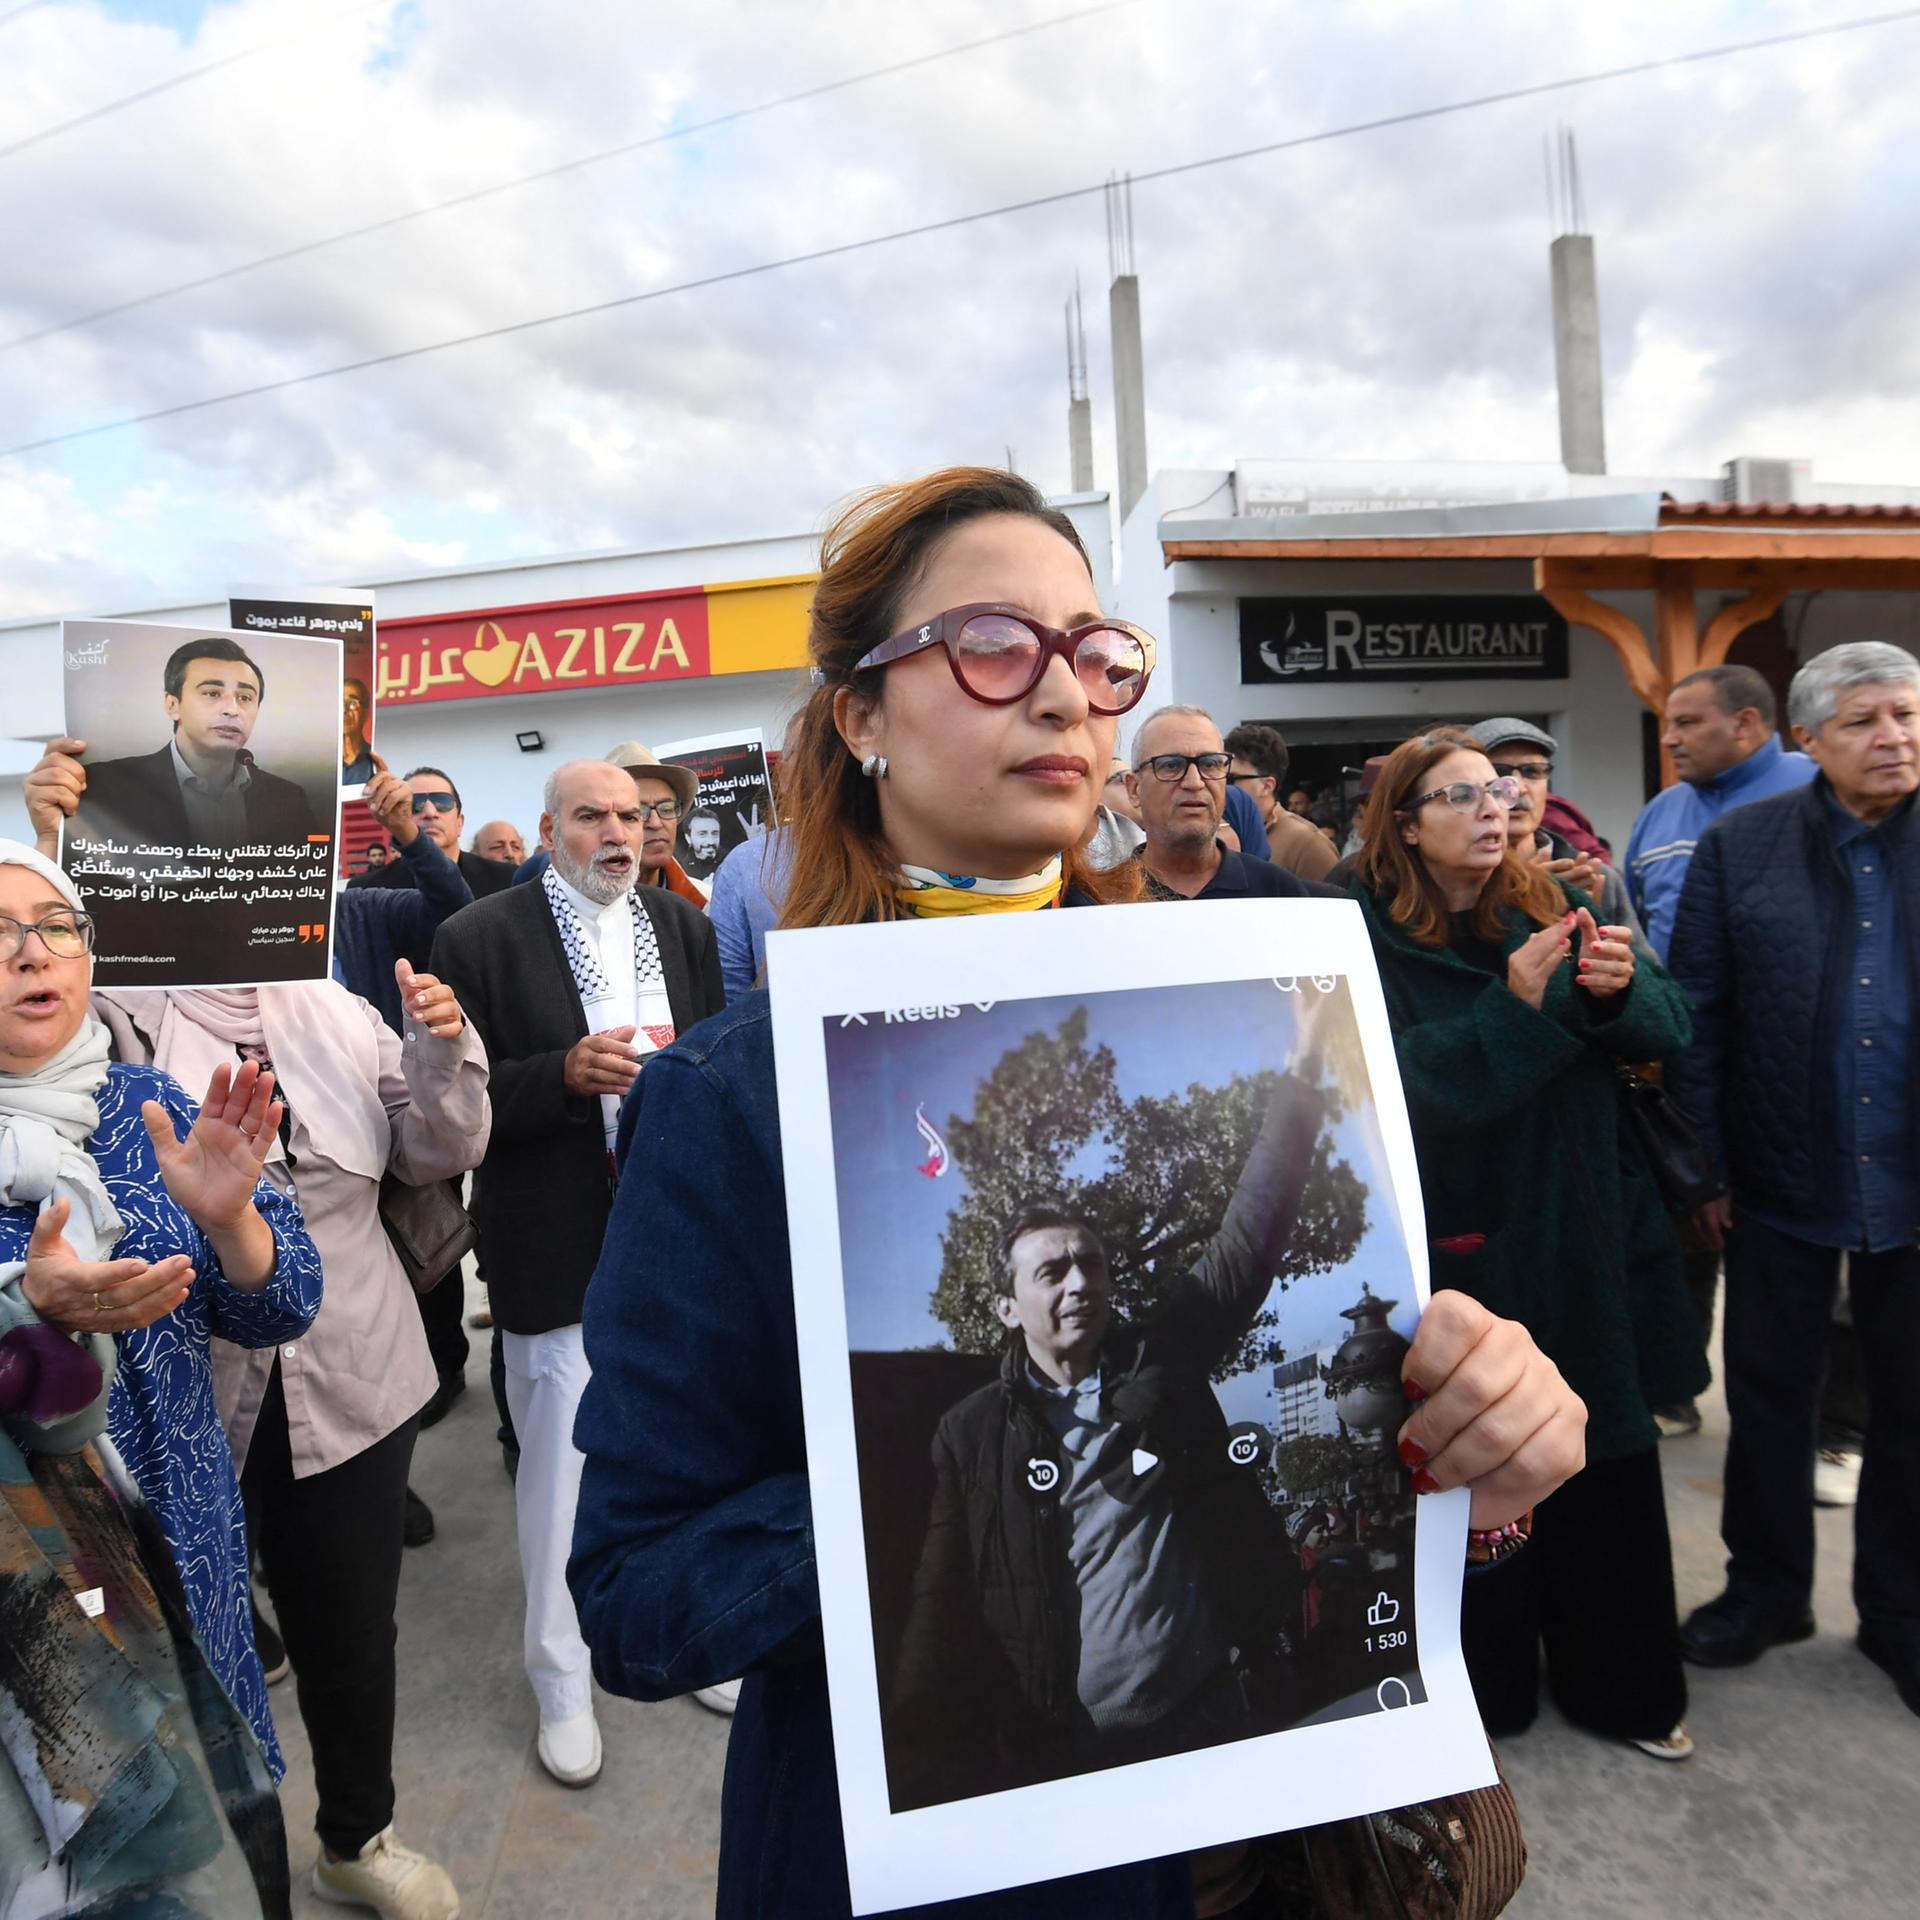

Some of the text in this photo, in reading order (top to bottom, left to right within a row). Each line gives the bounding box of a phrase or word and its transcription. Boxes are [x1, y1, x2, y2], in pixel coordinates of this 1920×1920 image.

[245, 613, 278, 629] يموت
[278, 616, 306, 628] قاعد
[1325, 609, 1548, 671] RESTAURANT
[513, 618, 690, 684] AZIZA
[375, 638, 465, 700] عزيز
[70, 838, 129, 855] سأجبرك
[187, 844, 222, 860] ببطء
[224, 844, 272, 862] تقتلني
[273, 843, 311, 860] أتركك
[312, 845, 328, 860] لن
[214, 867, 254, 881] وجهك
[256, 865, 297, 878] كشف
[299, 866, 327, 880] على
[98, 883, 138, 900] أموت
[140, 884, 155, 901] أو
[158, 886, 179, 902] حرا
[181, 885, 238, 902] سأعيش
[296, 886, 326, 900] يداك
[98, 955, 176, 964] kashfmedia.com
[884, 1001, 961, 1024] Reels
[1236, 1444, 1251, 1455] 10
[1035, 1469, 1051, 1481] 10
[1378, 1630, 1408, 1650] 530
